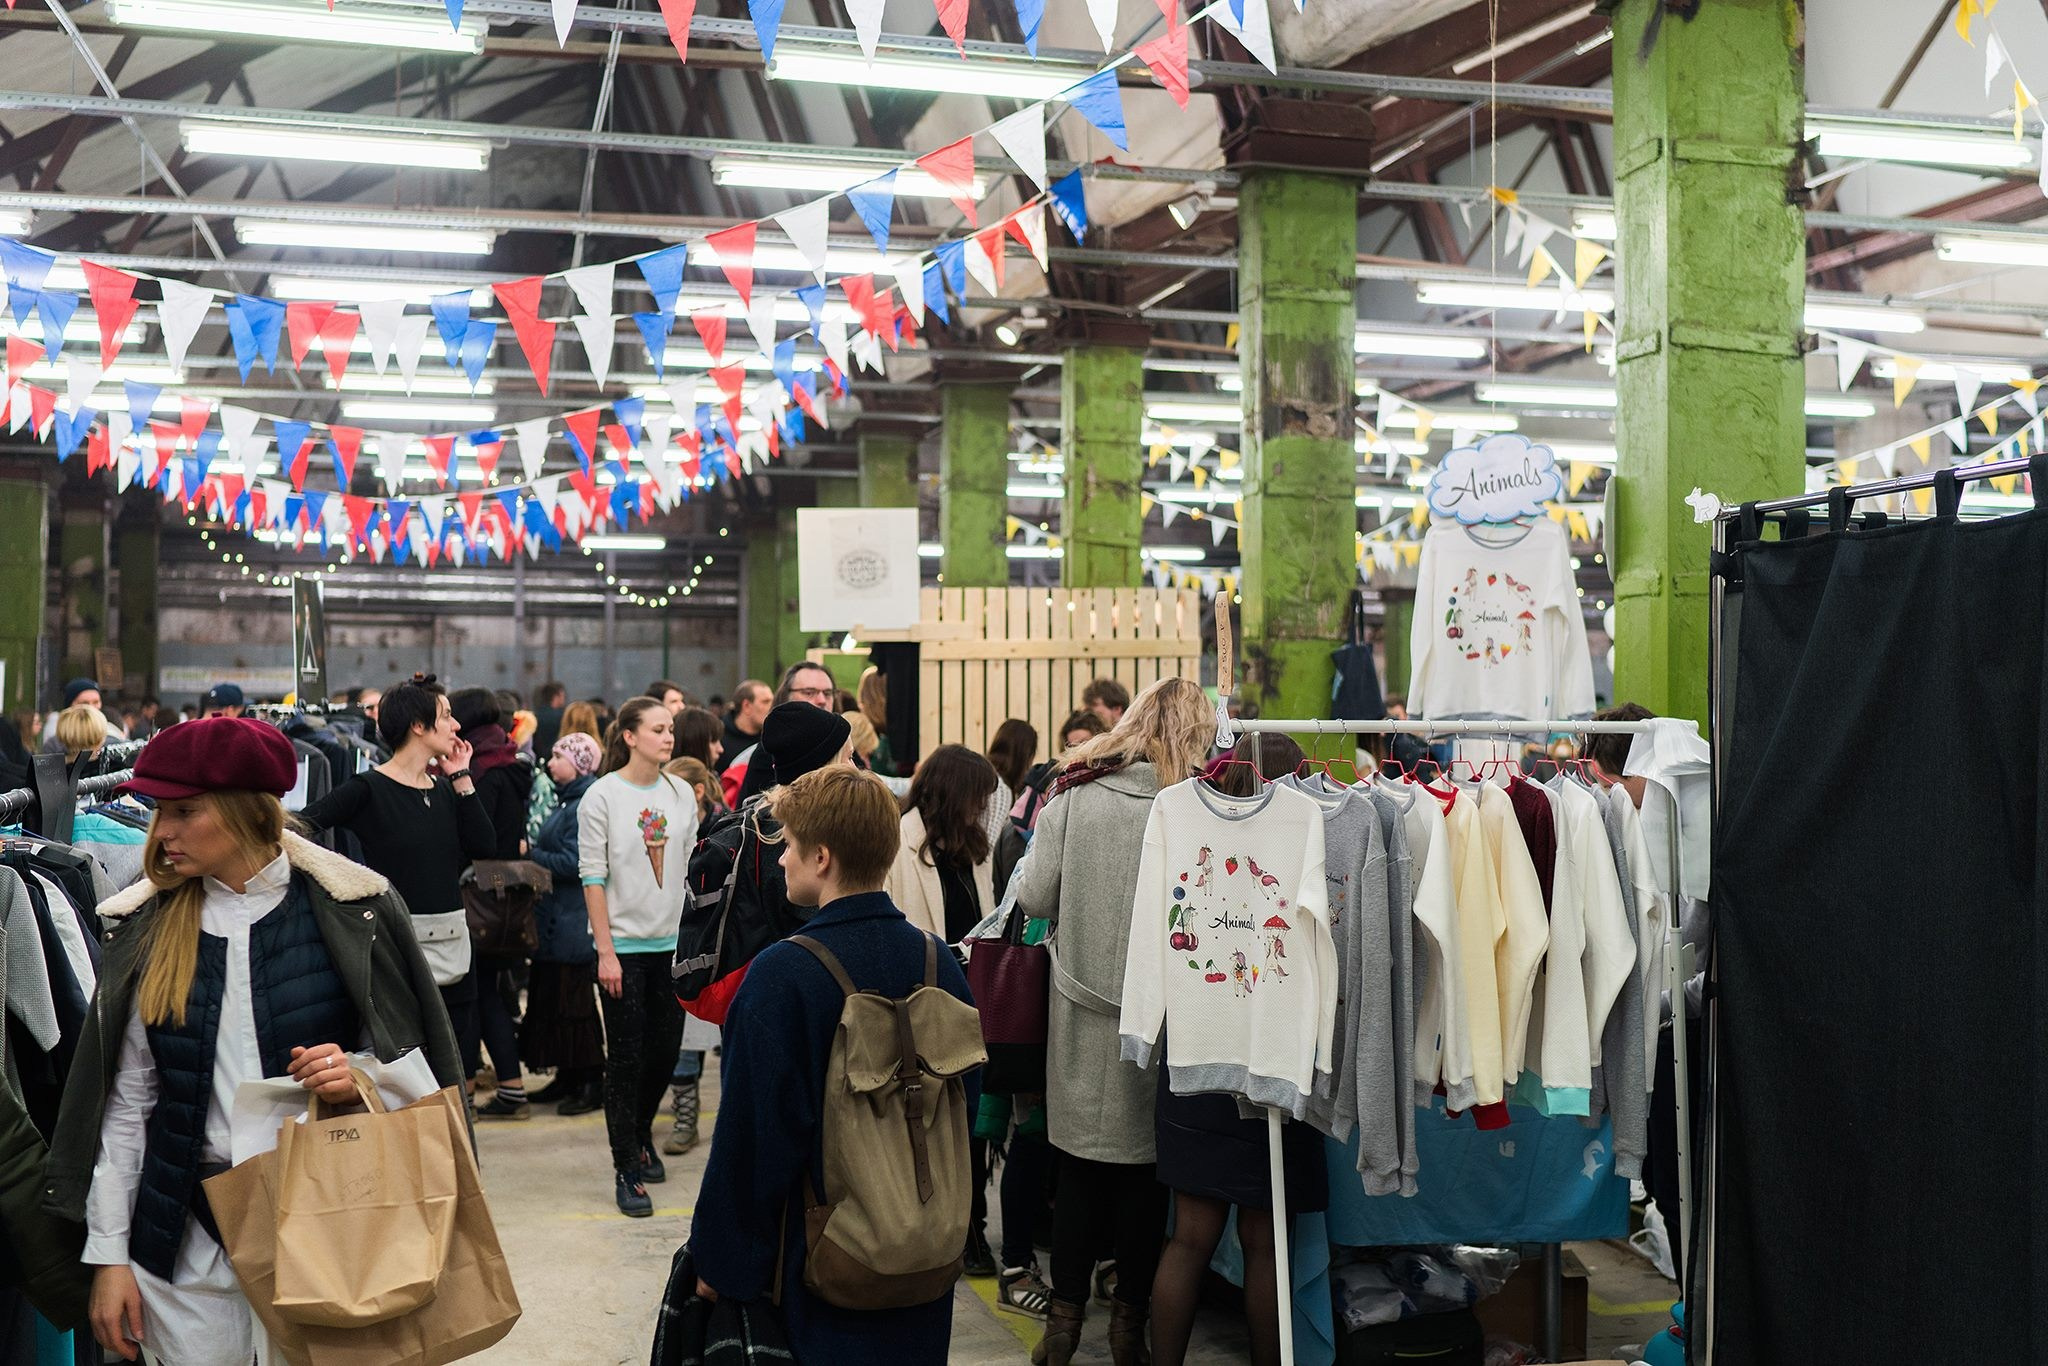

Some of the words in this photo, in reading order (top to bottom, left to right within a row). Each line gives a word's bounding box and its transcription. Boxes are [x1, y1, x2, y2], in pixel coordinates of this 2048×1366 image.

[1440, 457, 1542, 507] Animals
[1471, 610, 1508, 623] Animals
[1208, 910, 1256, 932] Animals
